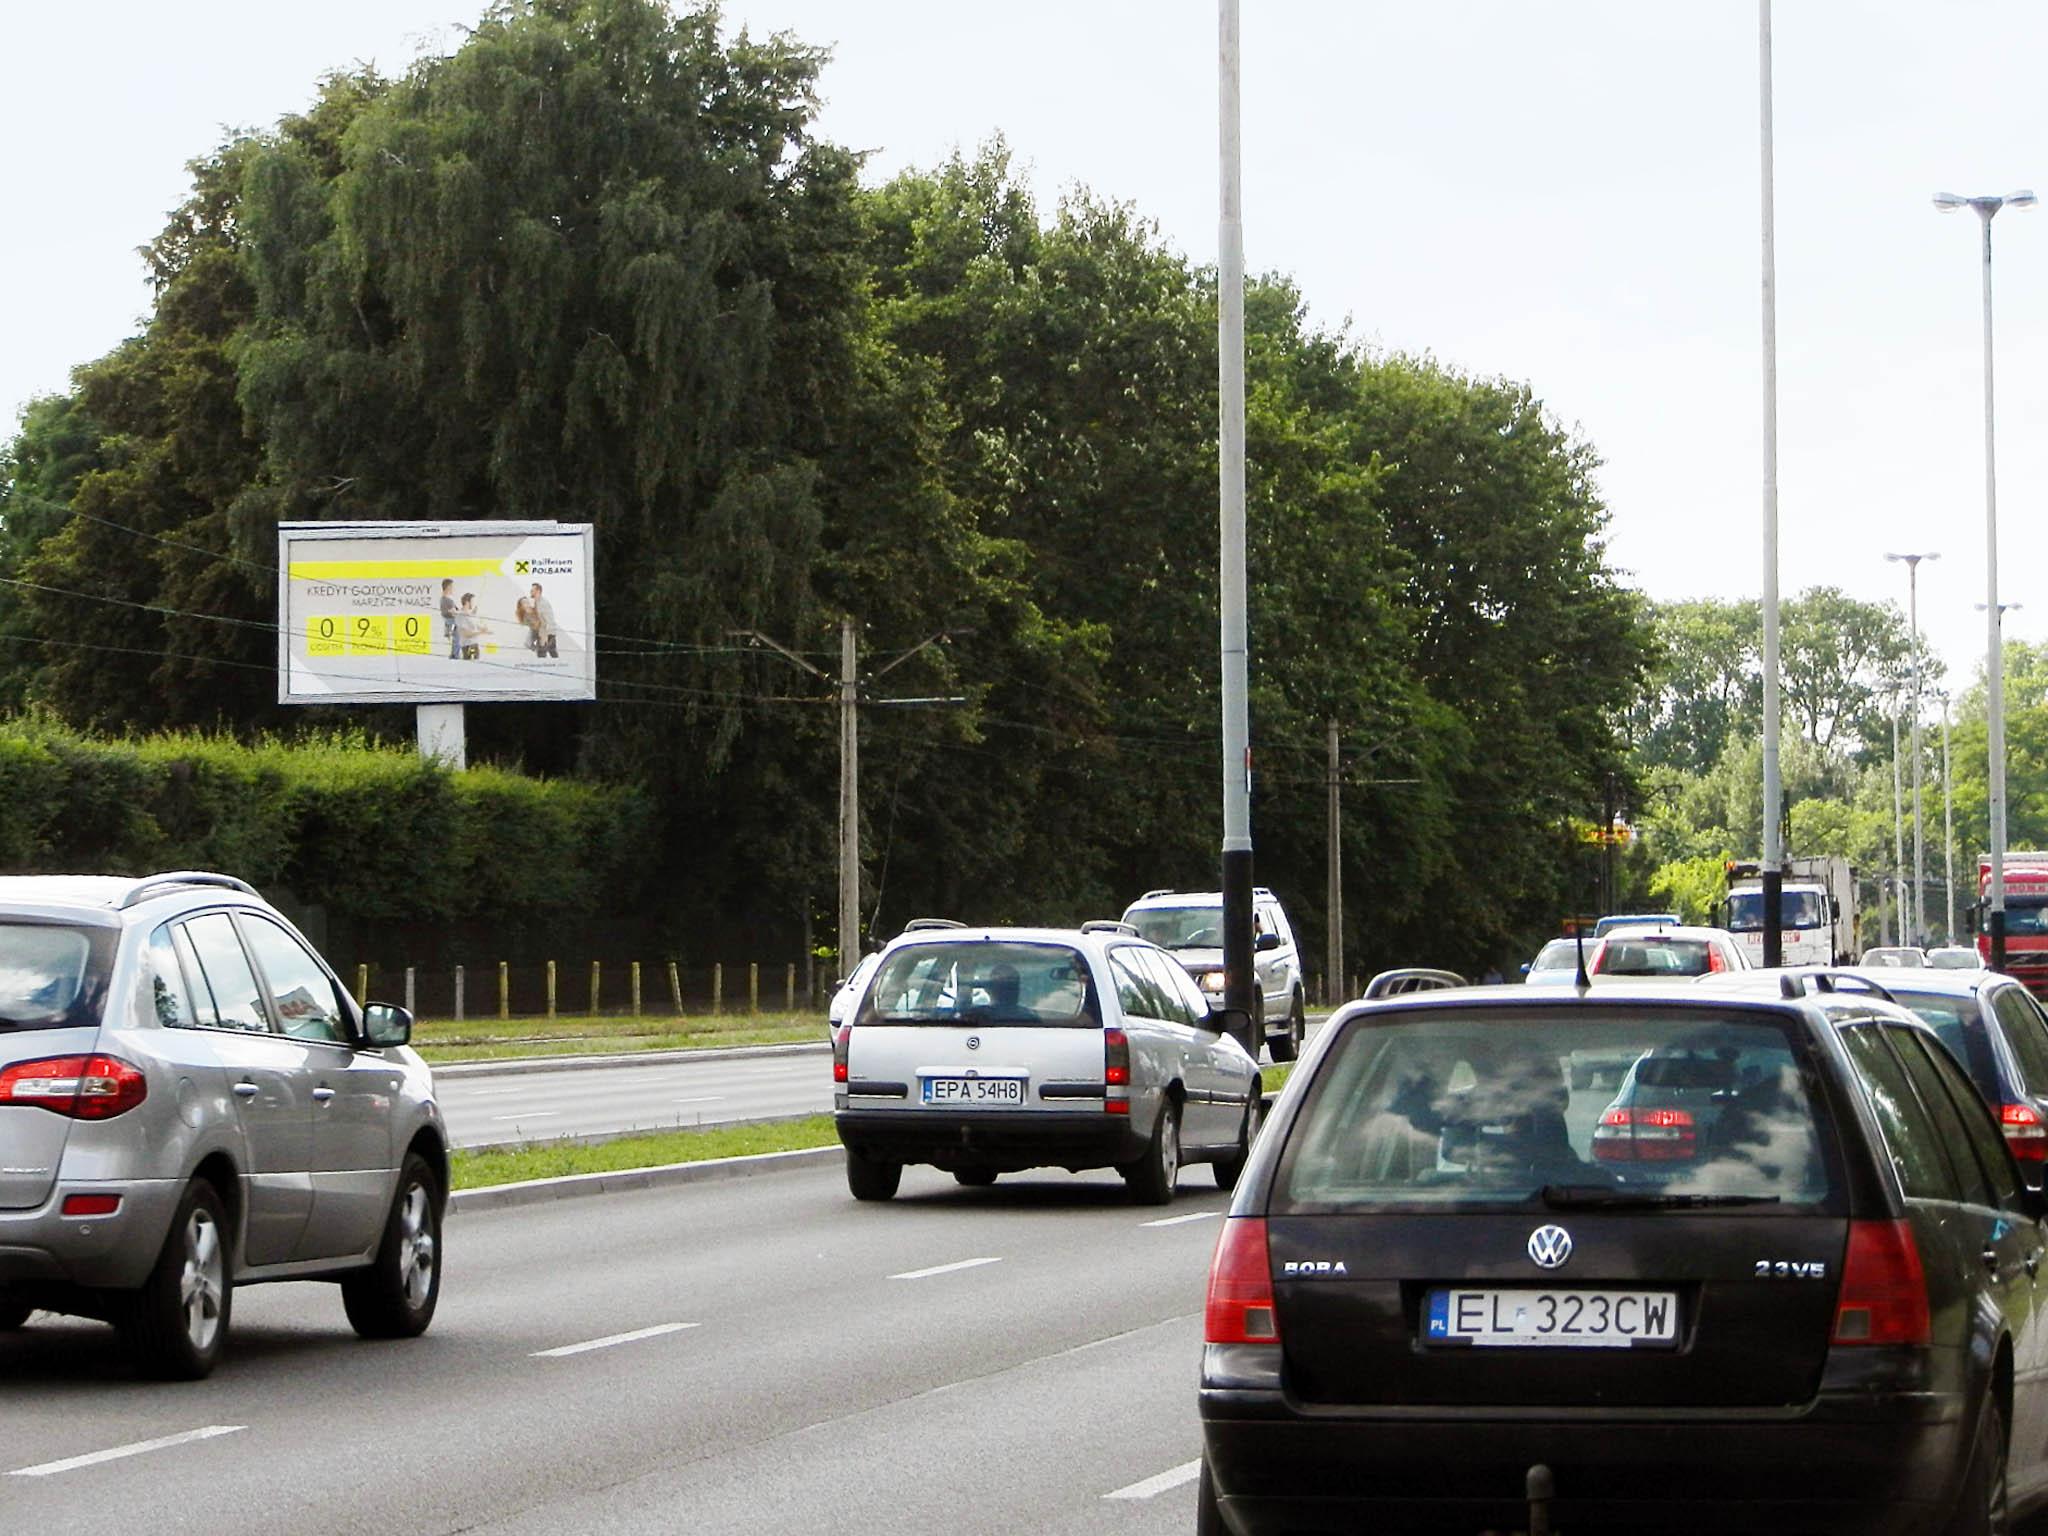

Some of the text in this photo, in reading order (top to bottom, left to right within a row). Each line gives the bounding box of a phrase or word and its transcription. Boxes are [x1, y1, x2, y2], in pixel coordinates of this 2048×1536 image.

[307, 586, 348, 596] KREDYT
[320, 618, 334, 638] 0
[405, 617, 419, 637] 0
[935, 1081, 971, 1099] EPA
[977, 1082, 1018, 1099] 54H8
[1283, 1261, 1348, 1276] BORA
[1456, 1294, 1668, 1336] EL 323CW
[1431, 1320, 1446, 1331] PL
